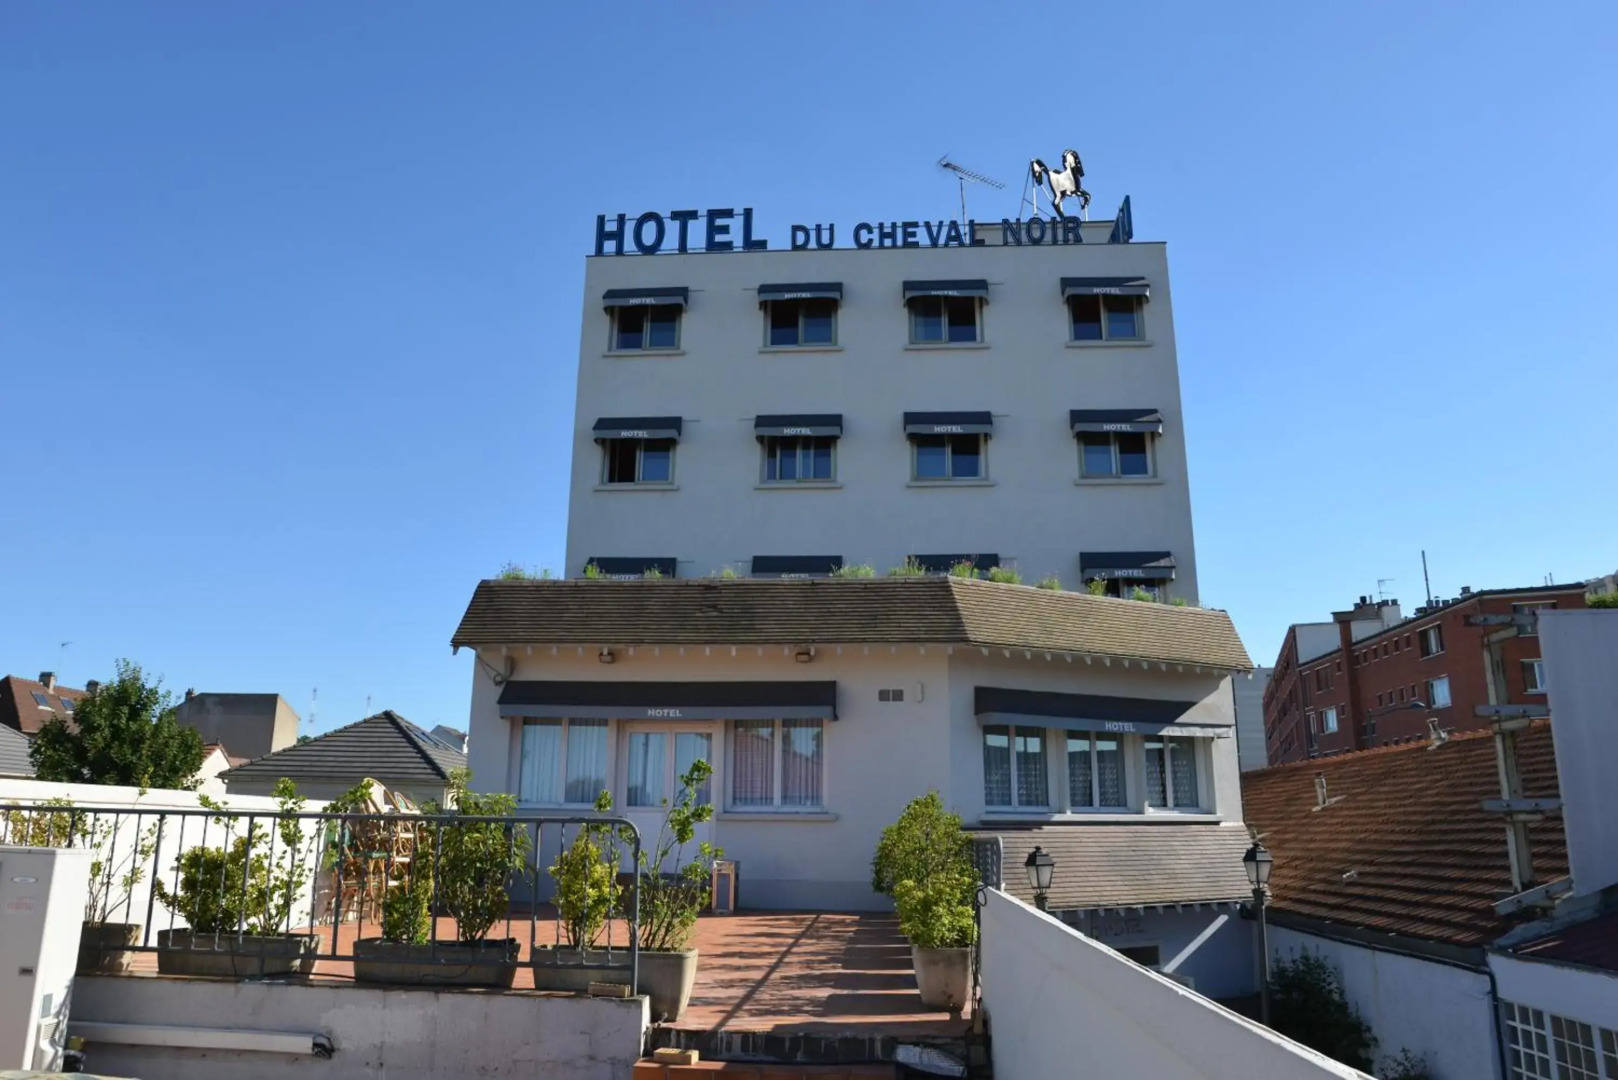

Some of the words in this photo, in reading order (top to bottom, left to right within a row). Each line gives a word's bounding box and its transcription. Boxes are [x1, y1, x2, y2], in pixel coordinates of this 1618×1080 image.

[594, 208, 768, 256] HOTEL
[791, 222, 835, 250] DU
[852, 219, 986, 249] CHEVAL
[1001, 215, 1084, 245] NOIR
[628, 297, 657, 305] HOTEL
[783, 427, 812, 435] HOTEL
[934, 425, 963, 433] HOTEL
[1114, 569, 1145, 577] HOTEL
[647, 708, 683, 717] HOTEL
[1105, 721, 1136, 732] HOTEL
